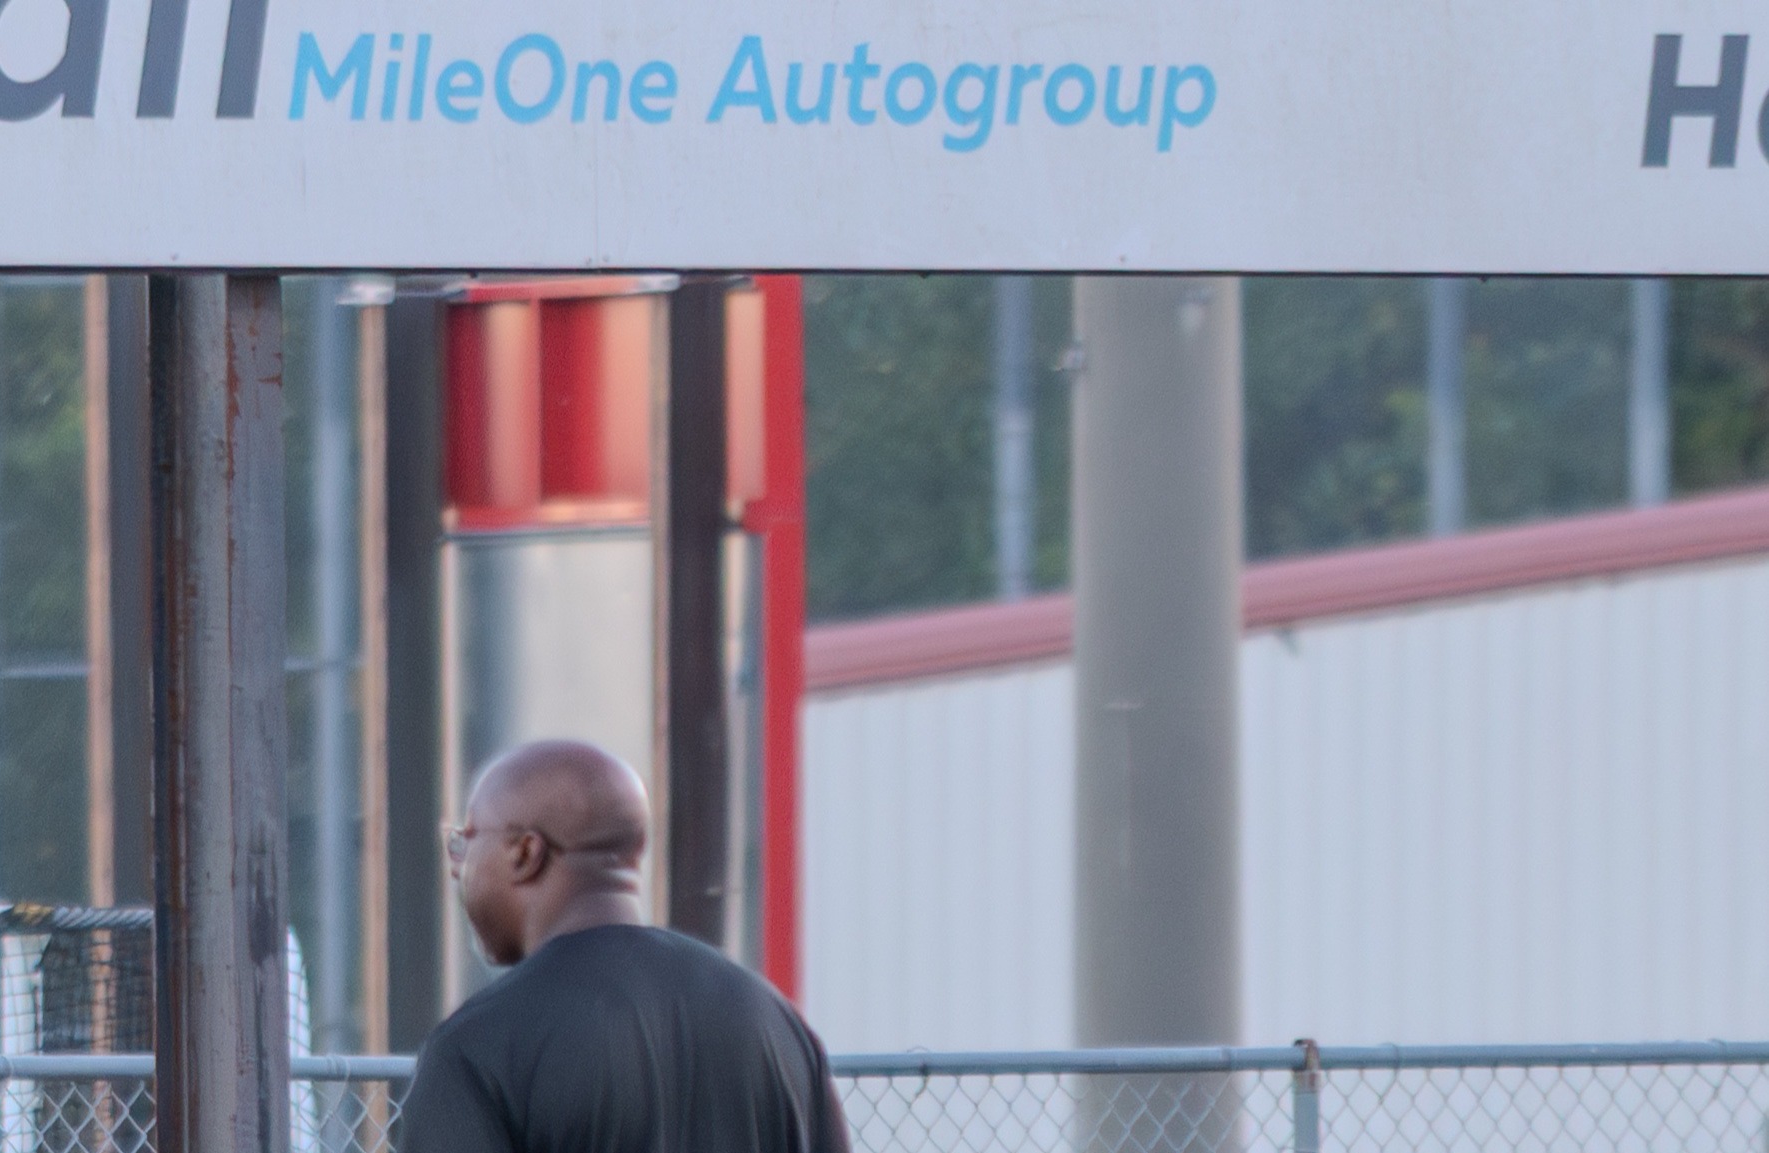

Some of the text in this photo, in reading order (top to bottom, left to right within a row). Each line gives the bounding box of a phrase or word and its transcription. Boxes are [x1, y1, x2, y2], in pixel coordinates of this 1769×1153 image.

[286, 30, 1219, 154] MileOne Autogroup
[1640, 33, 1769, 168] H
